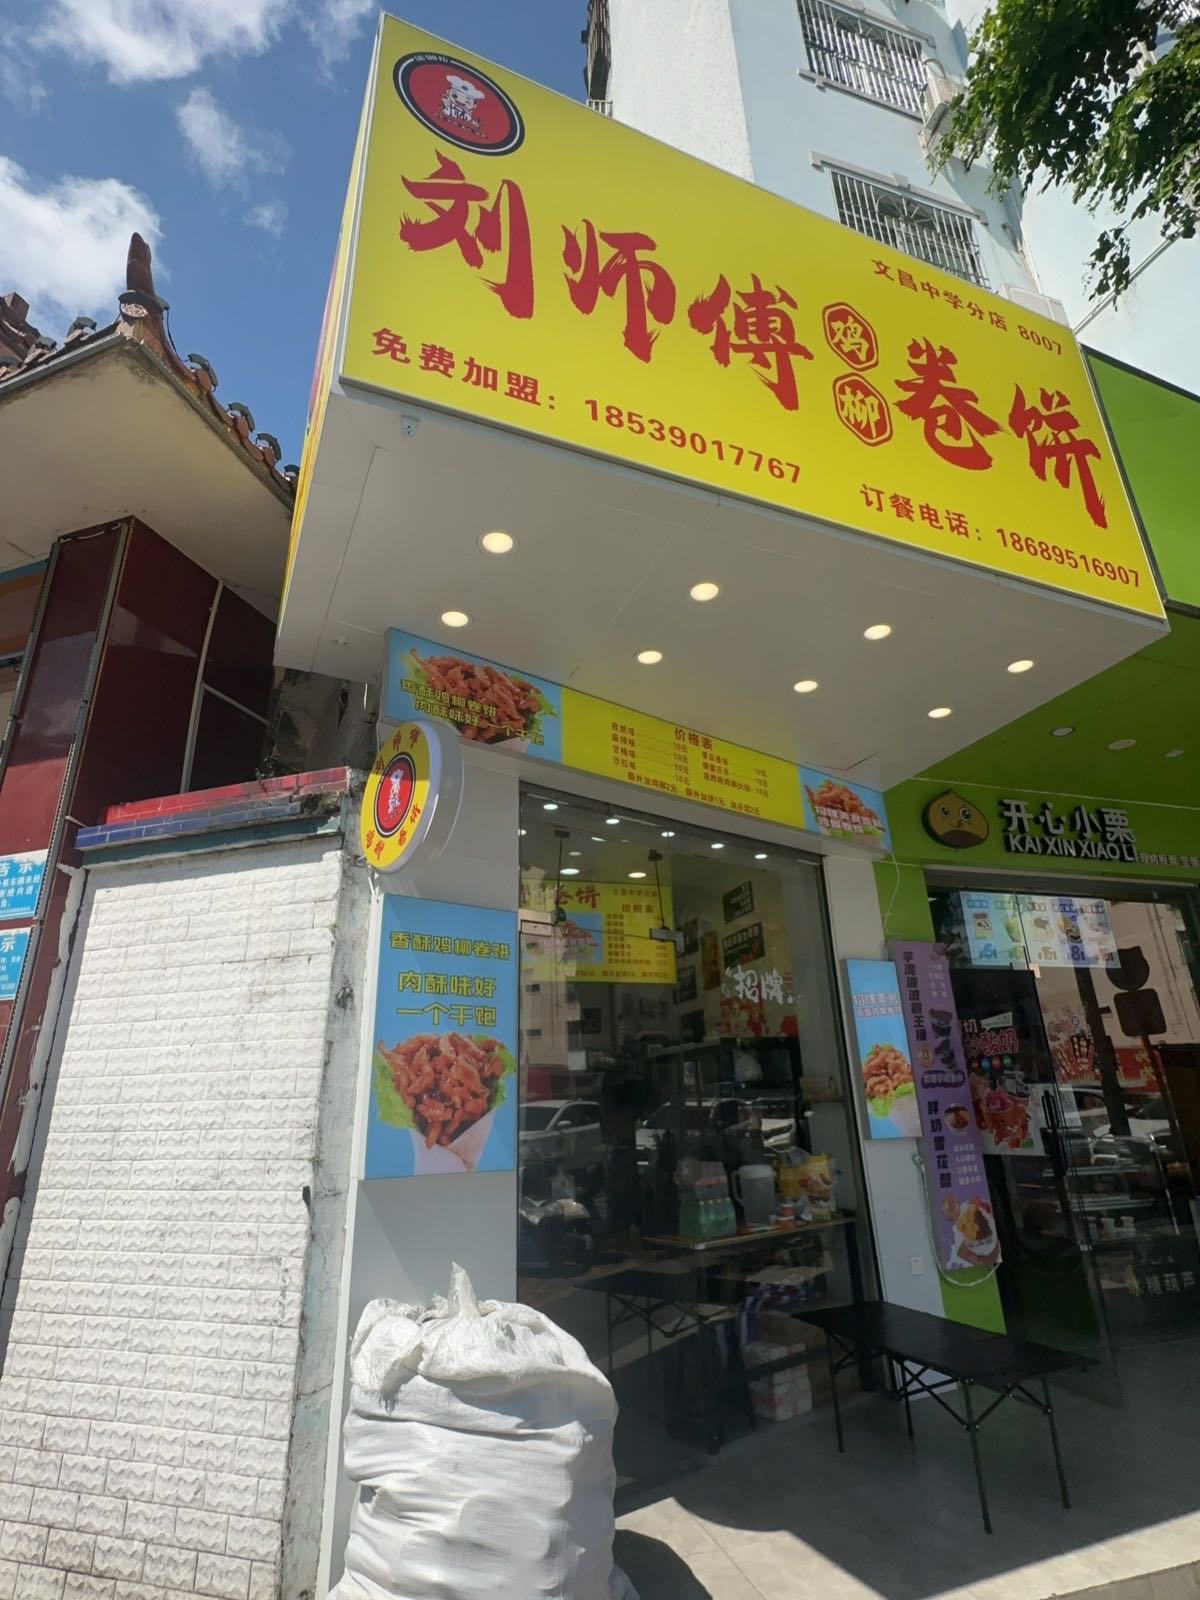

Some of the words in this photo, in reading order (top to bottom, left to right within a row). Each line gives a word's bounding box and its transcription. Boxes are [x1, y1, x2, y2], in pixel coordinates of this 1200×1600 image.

[870, 258, 1008, 332] 文昌中学分店
[1017, 324, 1063, 355] 8007
[399, 149, 814, 411] 刘师傅
[893, 337, 1109, 529] 卷饼
[584, 399, 801, 484] 18539017767
[996, 528, 1140, 588] 18689516907
[415, 700, 480, 727] 肉酥味好
[611, 721, 636, 738] 孜然味
[611, 733, 636, 748] 麻辣味
[674, 726, 713, 750] 价格表
[612, 744, 637, 759] 甘梅味
[612, 755, 637, 771] 沙拉味
[1009, 834, 1042, 854] KAI
[1046, 836, 1077, 857] XIN
[1079, 839, 1121, 860] XIAO
[1122, 844, 1138, 862] LI
[391, 931, 510, 961] 香酥鸡柳卷饼
[398, 971, 497, 998] 肉酥味好
[397, 1002, 497, 1027] 一个干饱
